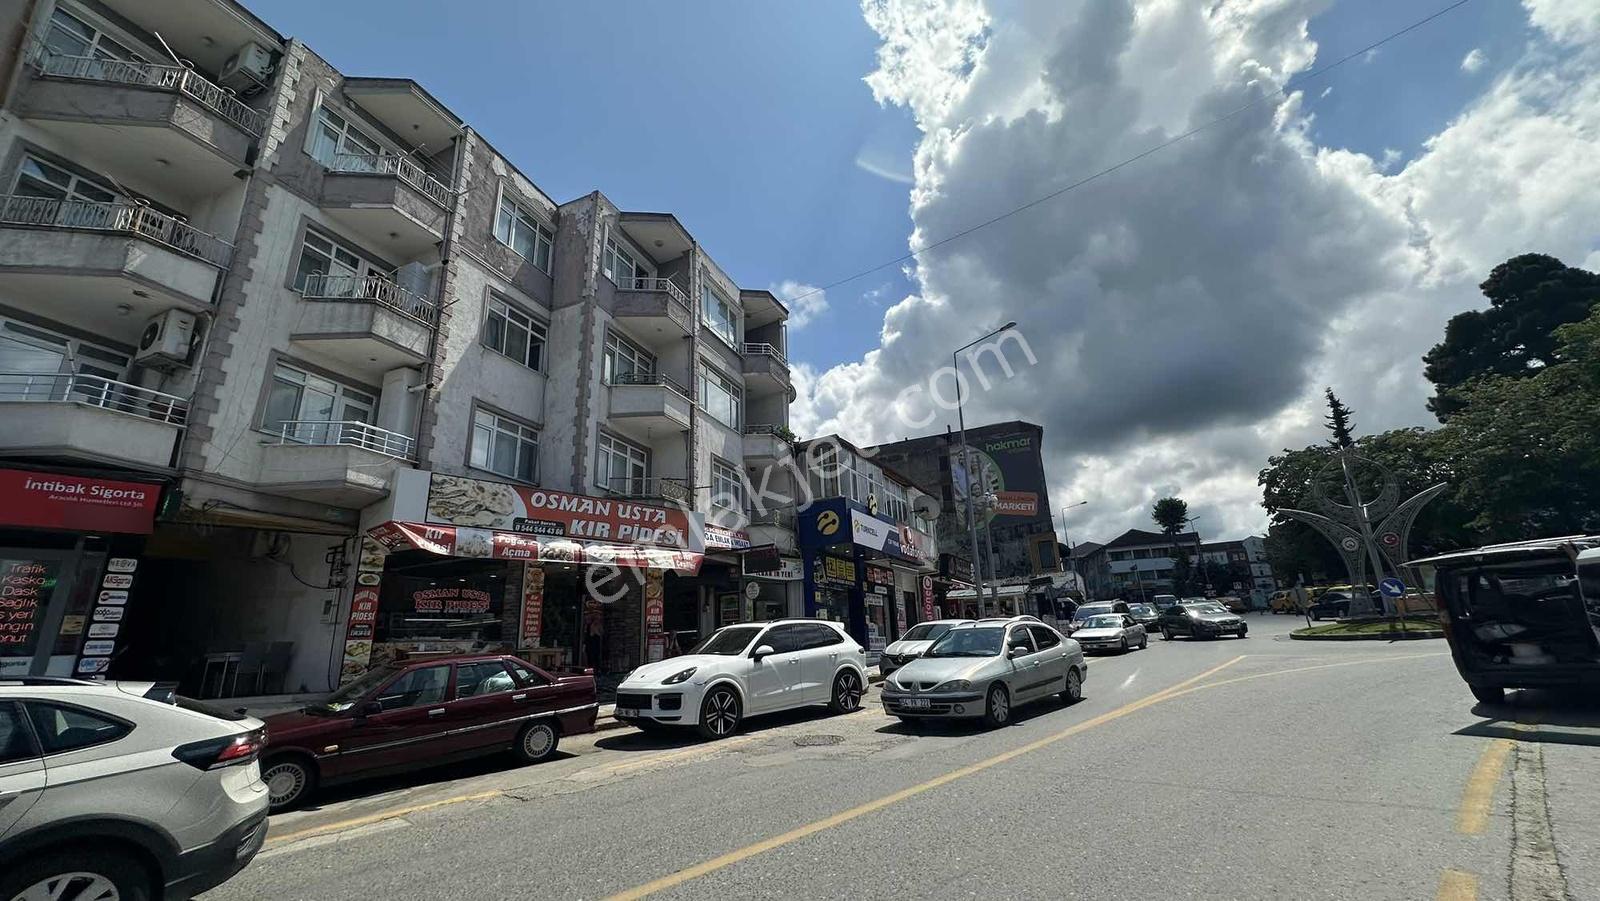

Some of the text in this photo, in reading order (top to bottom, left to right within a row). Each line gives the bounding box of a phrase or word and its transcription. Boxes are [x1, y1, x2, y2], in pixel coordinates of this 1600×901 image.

[986, 438, 1031, 451] hakmar
[25, 476, 145, 501] İntibak Sigorta
[530, 490, 666, 524] OSMAN USTA
[569, 518, 684, 546] KIR PİDESİ
[502, 547, 531, 558] Açma
[11, 562, 47, 575] Trafik
[2, 575, 46, 586] Kasko
[2, 585, 39, 597] Dask
[0, 621, 34, 634] angın
[0, 634, 27, 643] onut
